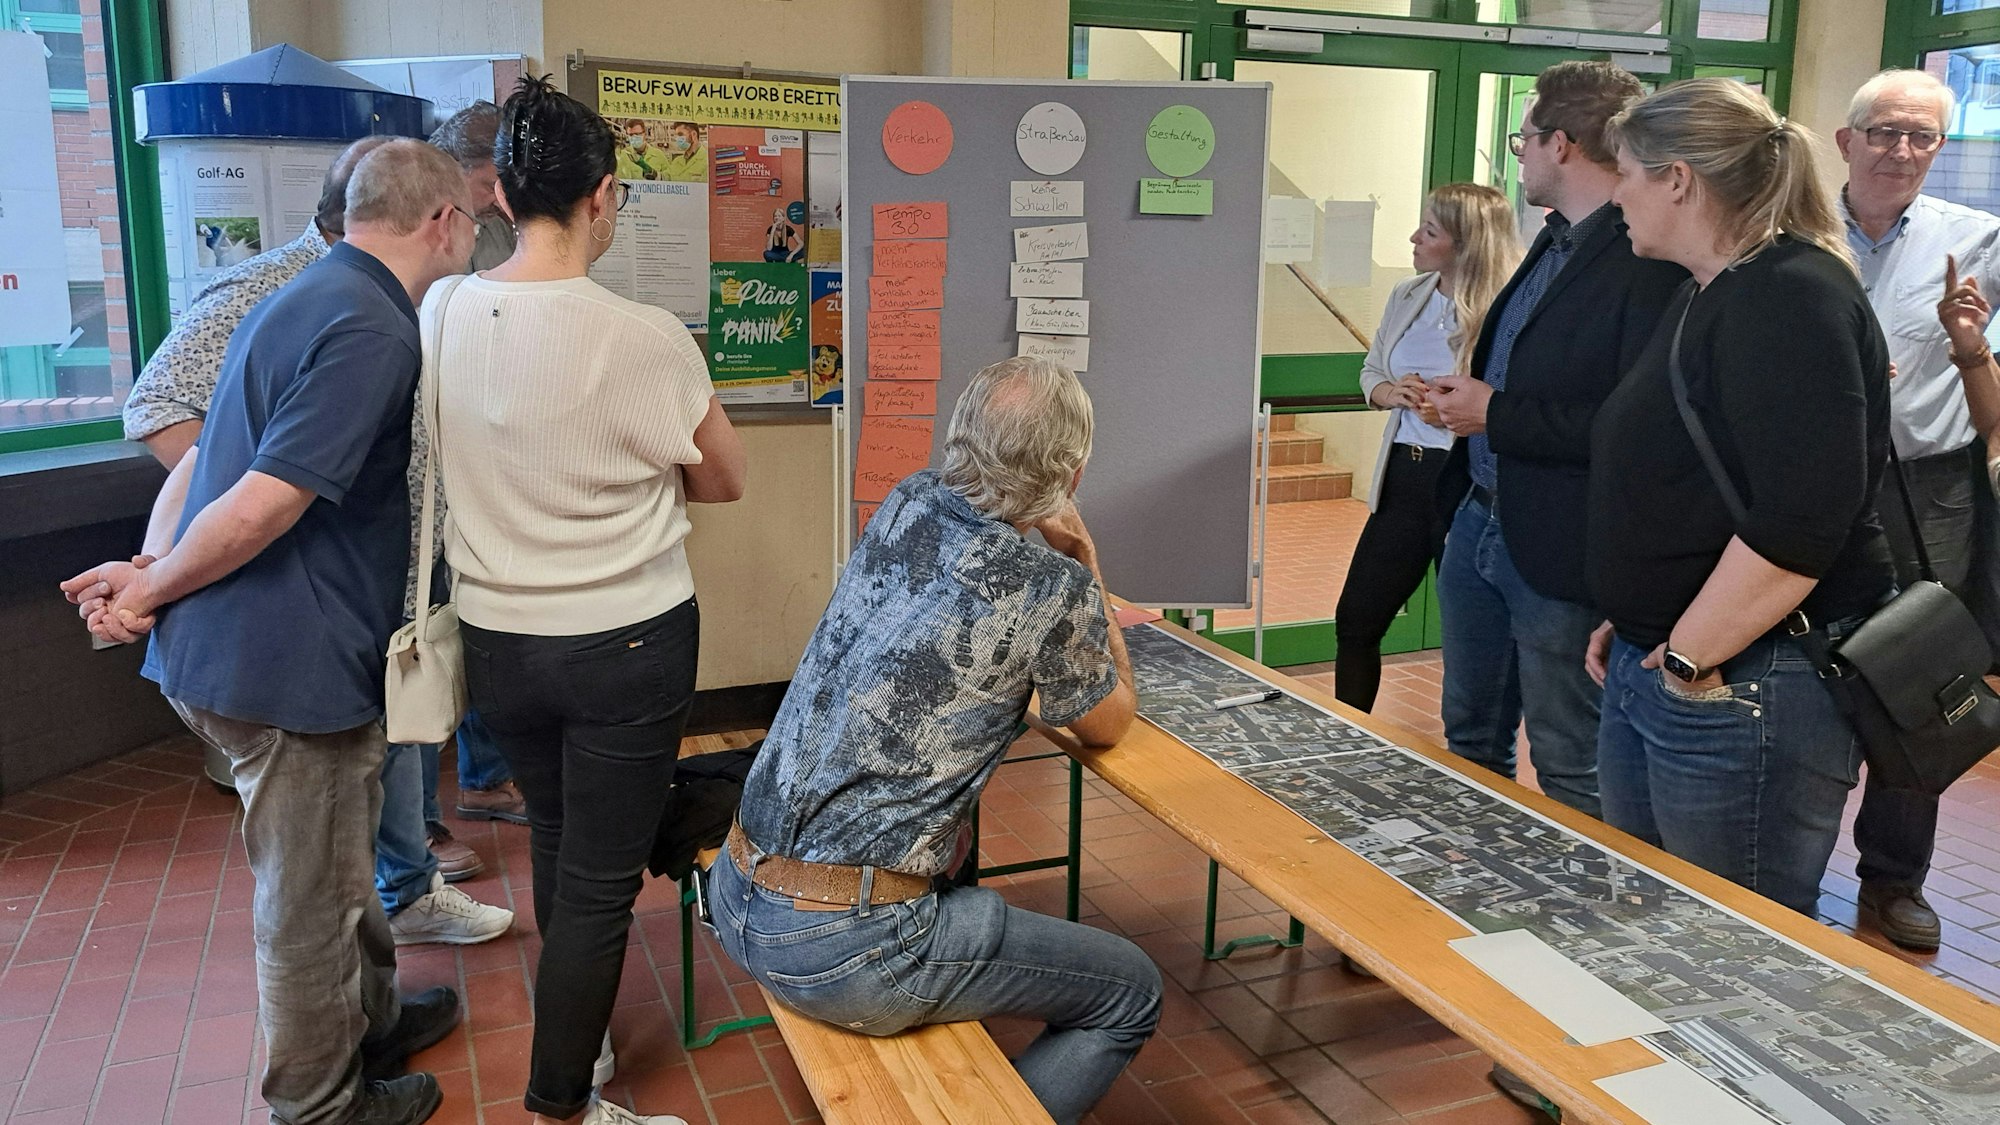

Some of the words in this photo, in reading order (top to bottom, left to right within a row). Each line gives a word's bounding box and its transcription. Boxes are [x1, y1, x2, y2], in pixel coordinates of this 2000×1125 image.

[886, 125, 943, 145] Verkehr
[1148, 125, 1206, 150] Gestaltung
[197, 167, 245, 179] Golf-AG
[739, 162, 767, 170] DURCH-
[635, 183, 690, 195] LYONDELLBASELL
[1015, 196, 1069, 212] Schwellen
[878, 207, 931, 224] Tempo
[891, 220, 920, 235] 30
[713, 268, 736, 276] Lieber
[736, 279, 799, 308] Pläne
[721, 316, 784, 345] PANIK
[1026, 345, 1077, 360] Markierungen
